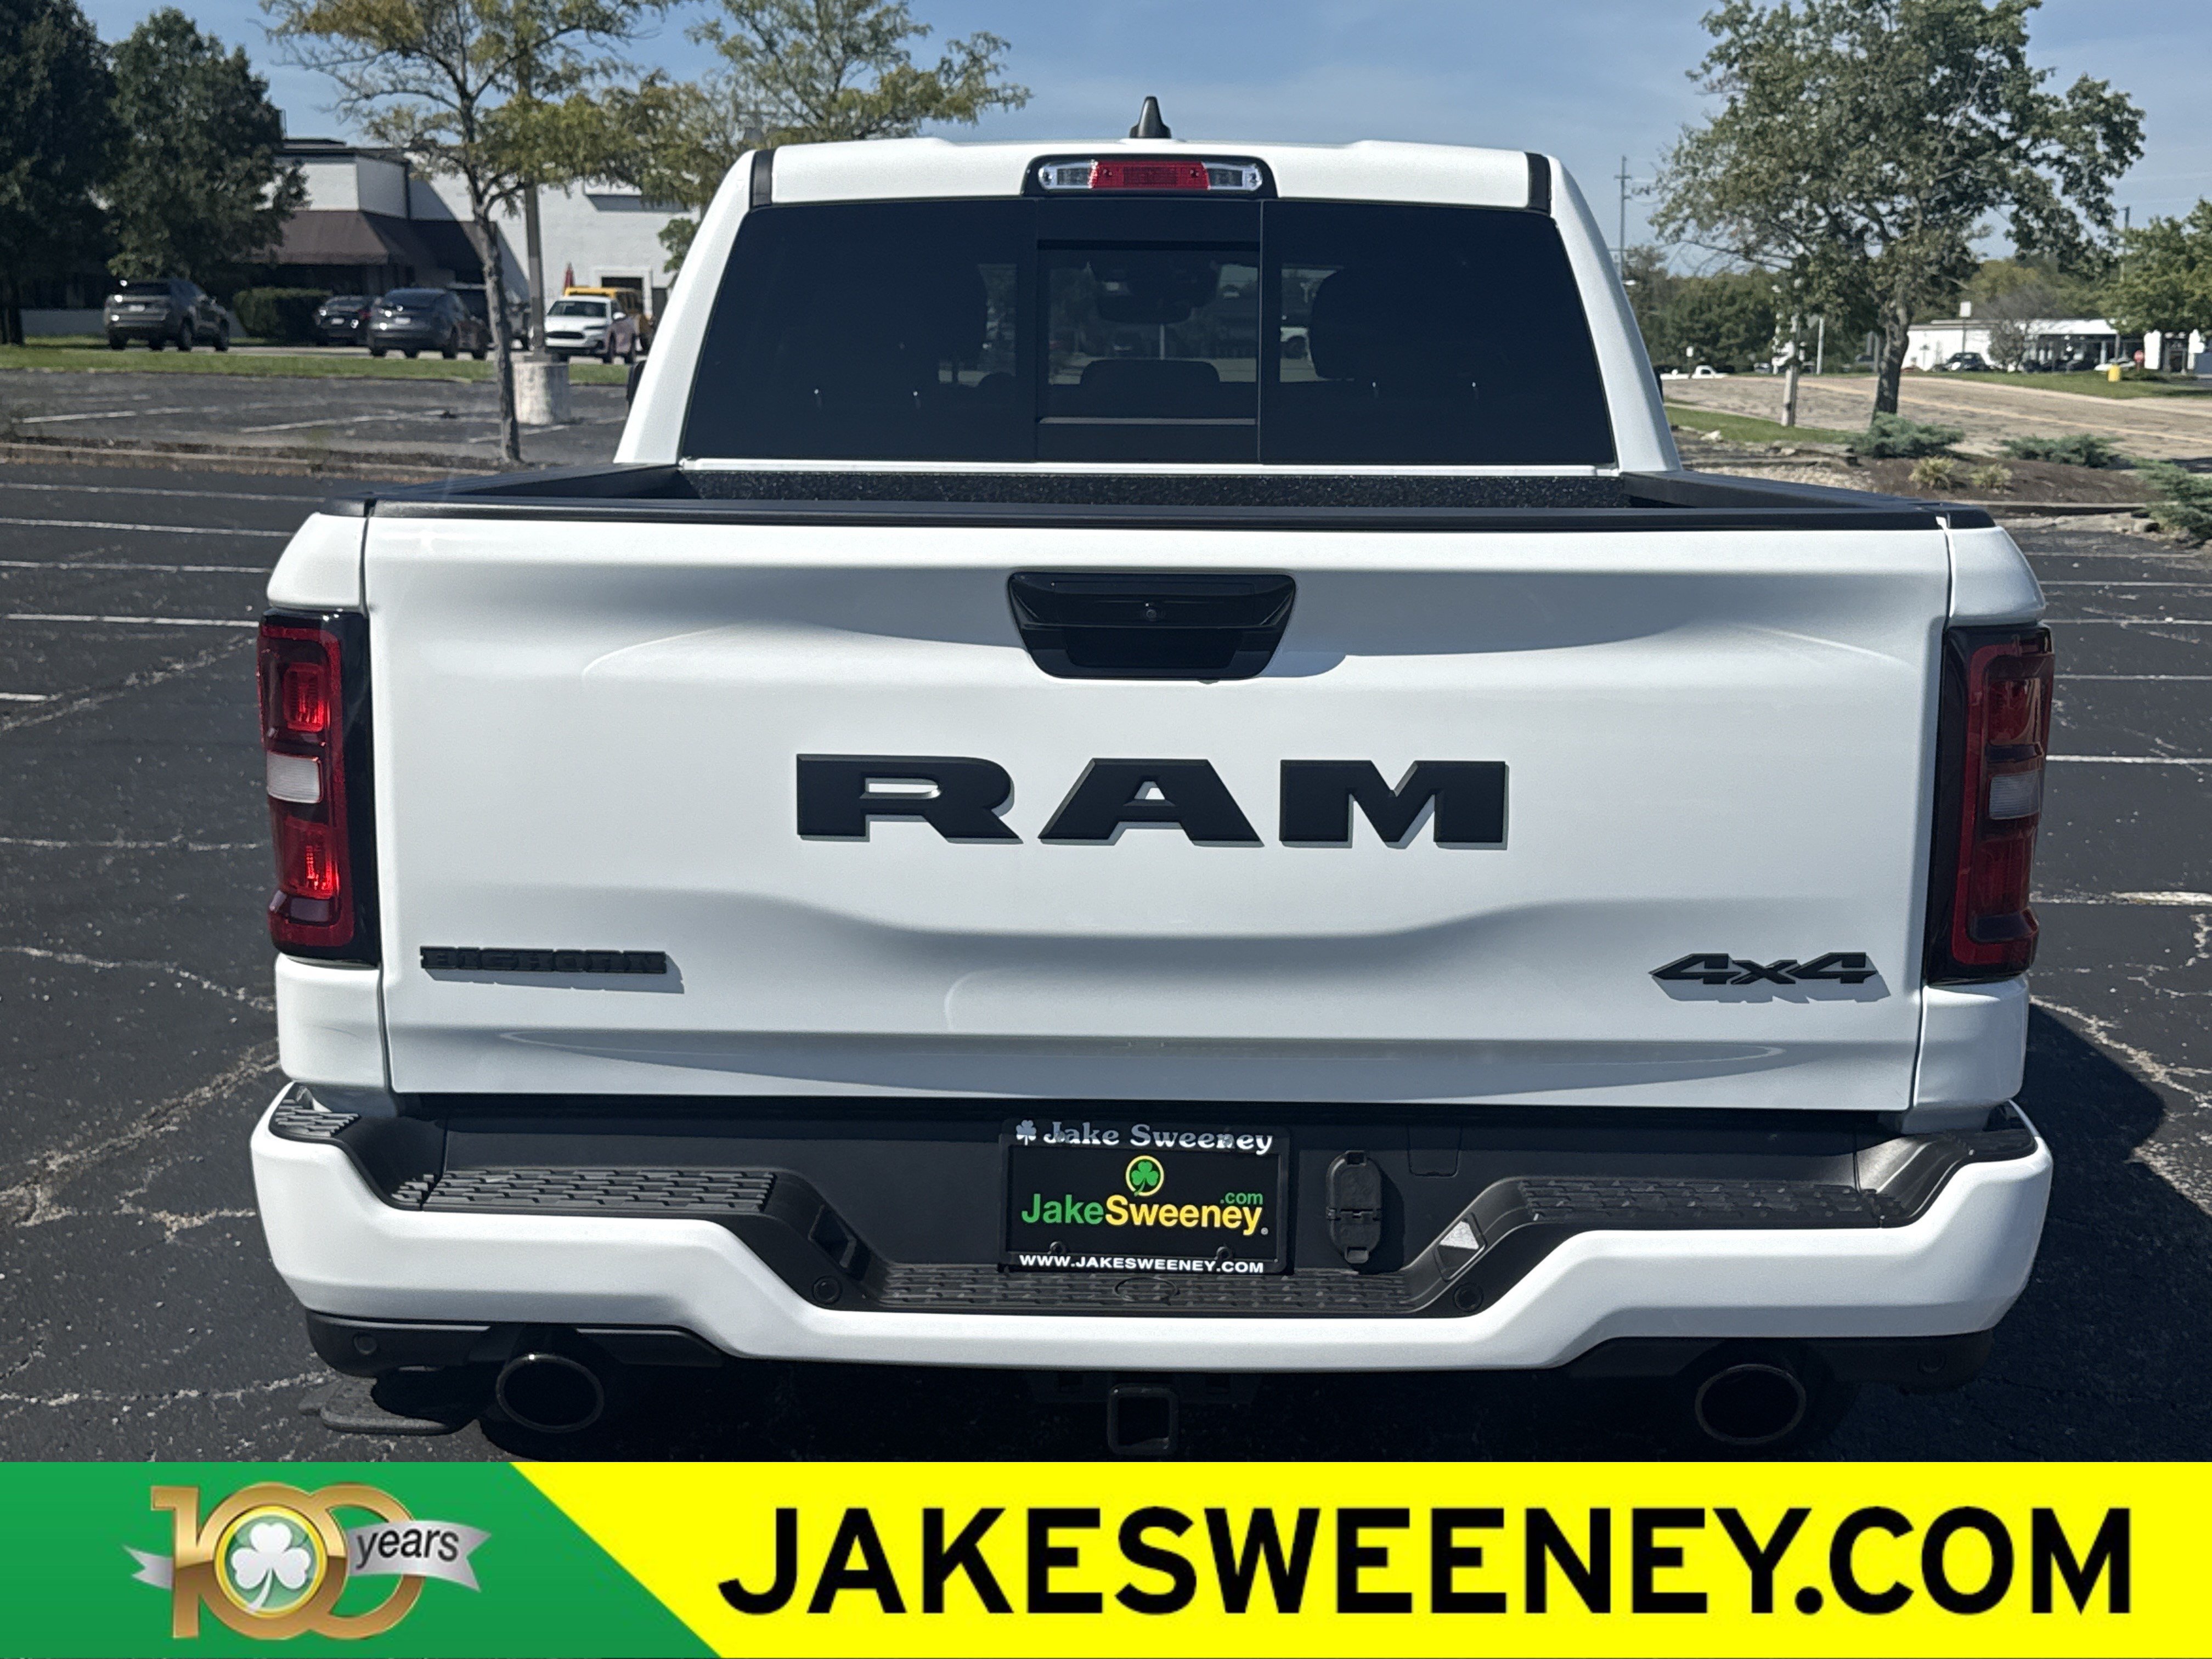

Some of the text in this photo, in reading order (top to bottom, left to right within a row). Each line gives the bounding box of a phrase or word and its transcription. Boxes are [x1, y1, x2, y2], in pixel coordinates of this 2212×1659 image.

[797, 753, 1509, 849] RAM
[1647, 952, 1878, 985] 4x4
[1043, 1121, 1273, 1155] Jake Sweeney
[1019, 1255, 1263, 1273] WWW.JAKESWEENEY.COM
